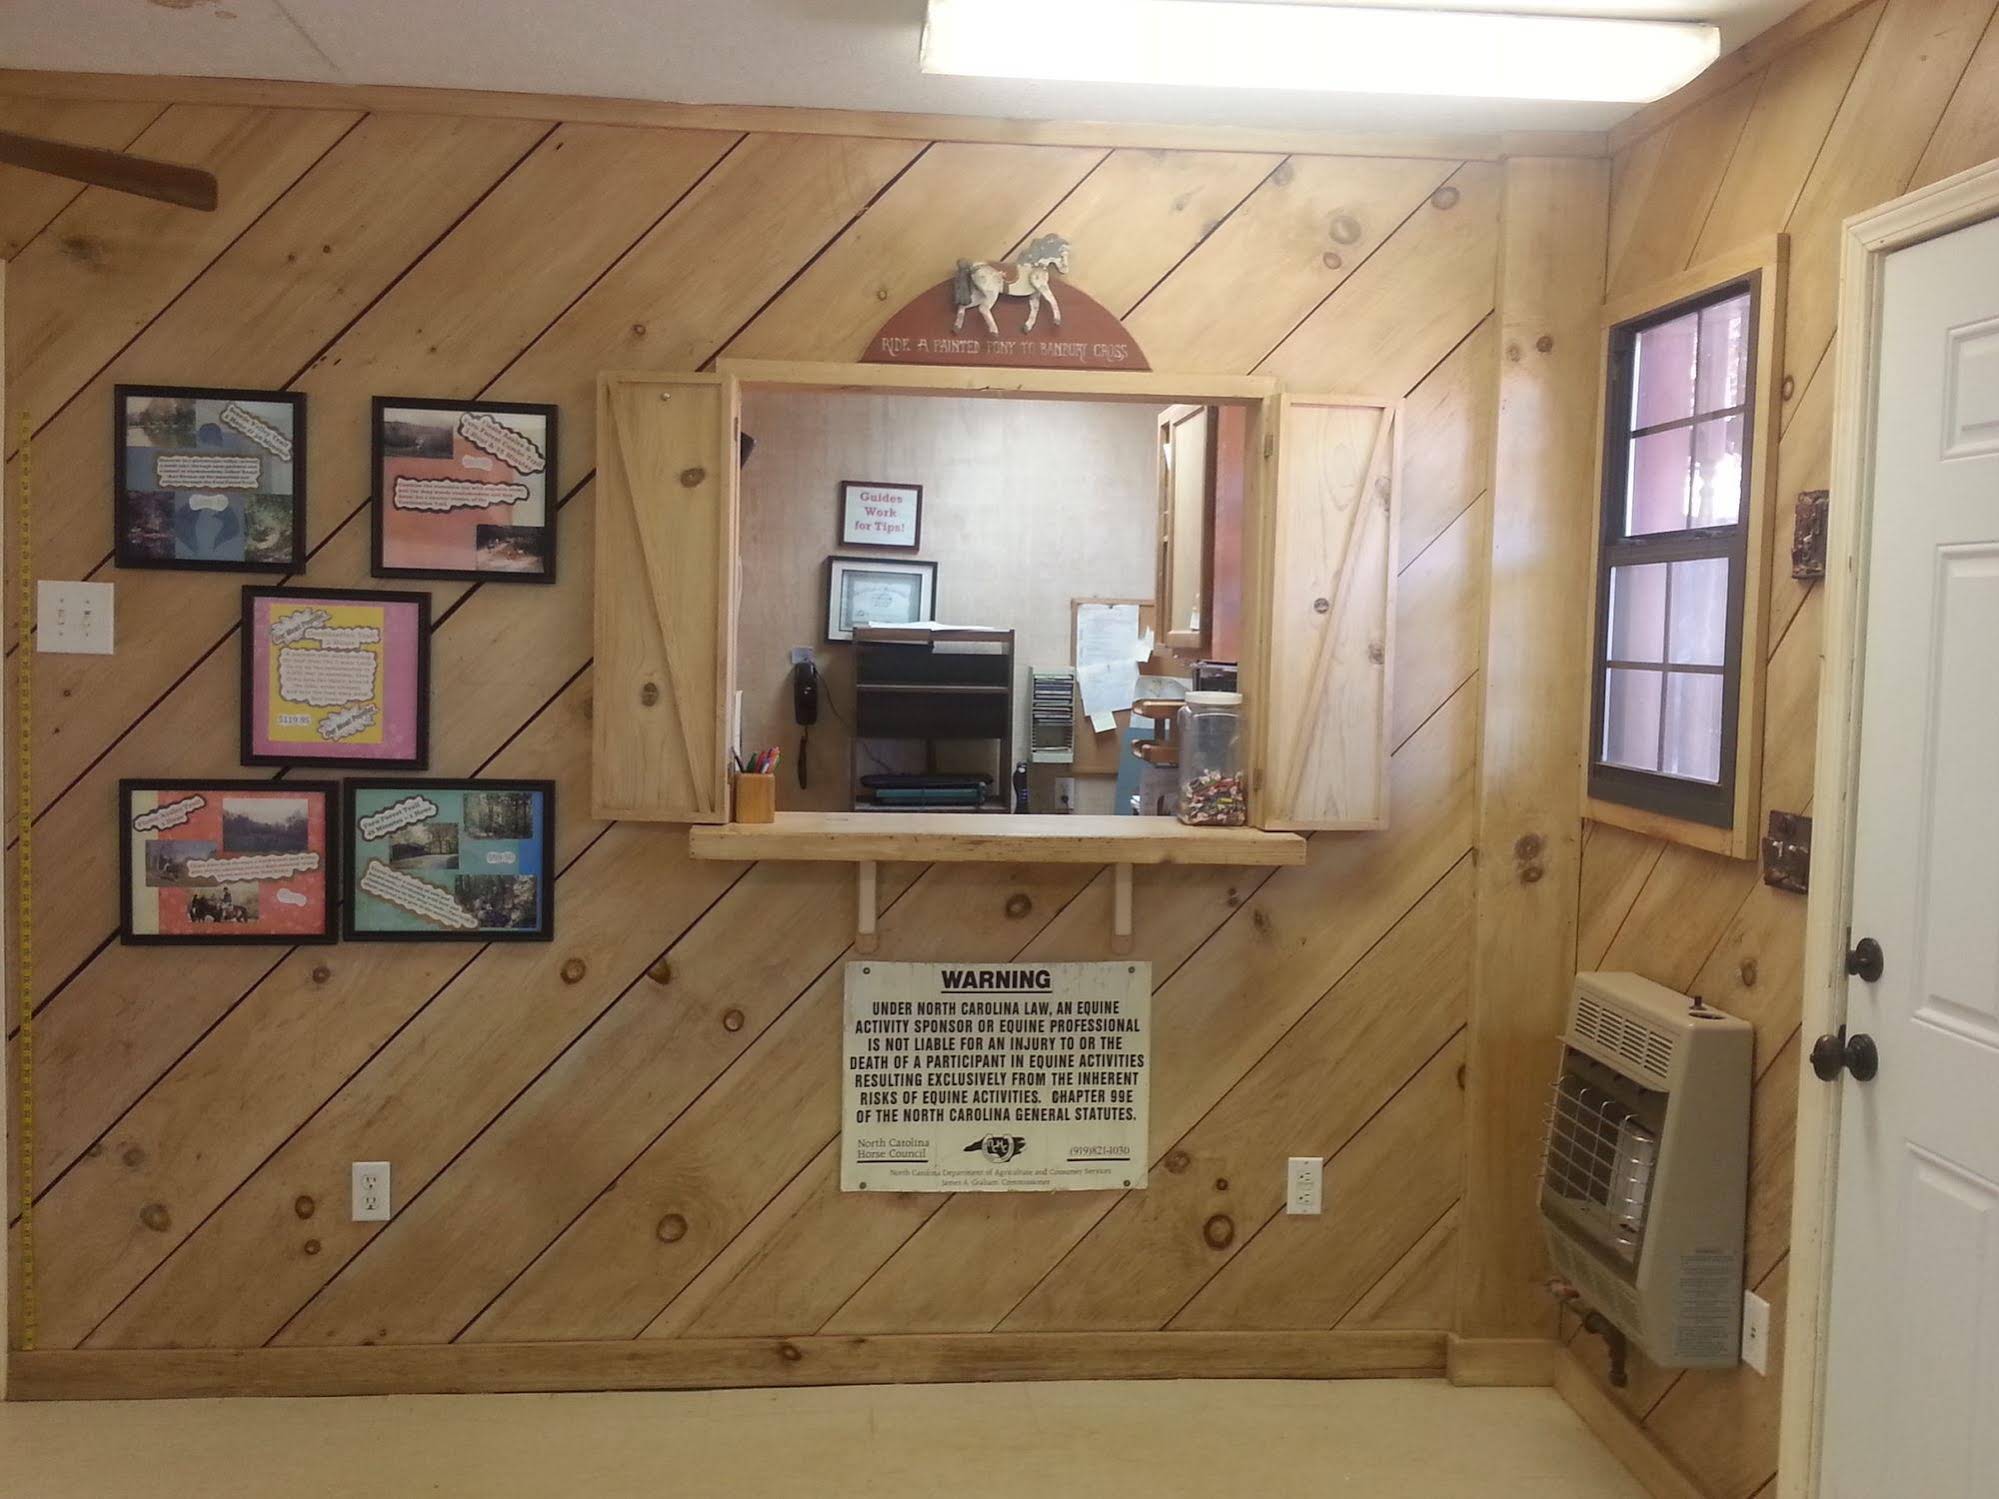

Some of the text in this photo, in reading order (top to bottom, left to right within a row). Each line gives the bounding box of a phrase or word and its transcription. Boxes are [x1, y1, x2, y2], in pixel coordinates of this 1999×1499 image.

[882, 337, 911, 357] RIDE
[917, 339, 929, 352] A
[934, 340, 979, 354] PAINTED
[987, 341, 1016, 355] PONY
[1020, 341, 1033, 355] TO
[1093, 343, 1128, 362] CROSS
[860, 492, 903, 503] Guides
[864, 507, 897, 517] Work
[855, 521, 905, 534] for Tips!
[403, 801, 421, 814] Trail
[941, 970, 1051, 989] WARNING
[872, 1001, 1120, 1016] UNDER NORTH CAROLINA LAW, AN EQUINE
[855, 1018, 1140, 1034] ACTIVITY SPONSOR OR EQUINE PROFESSIONAL
[868, 1036, 1122, 1051] IS NOT LIABLE FOR AN INJURY TO OR THE
[850, 1054, 1144, 1070] DEATH OF A PARTICIPANT IN EQUINE ACTIVITIES
[855, 1072, 1139, 1087] RESULTING EXCLUSIVELY FROM THE INHERENT
[860, 1090, 1133, 1105] RISKS OF EQUINE ACTIVITIES. CHAPTER 99E
[856, 1107, 1136, 1123] OF THE NORTH CAROLINA GENERAL STATUTES.
[857, 1138, 930, 1148] North Carolina
[857, 1148, 926, 1158] Horse Council
[912, 1168, 941, 1176] Carolina
[942, 1168, 984, 1177] Department
[985, 1168, 993, 1176] of
[994, 1168, 1033, 1177] Agriculture
[1034, 1167, 1048, 1175] and
[1084, 1167, 1112, 1175] Services
